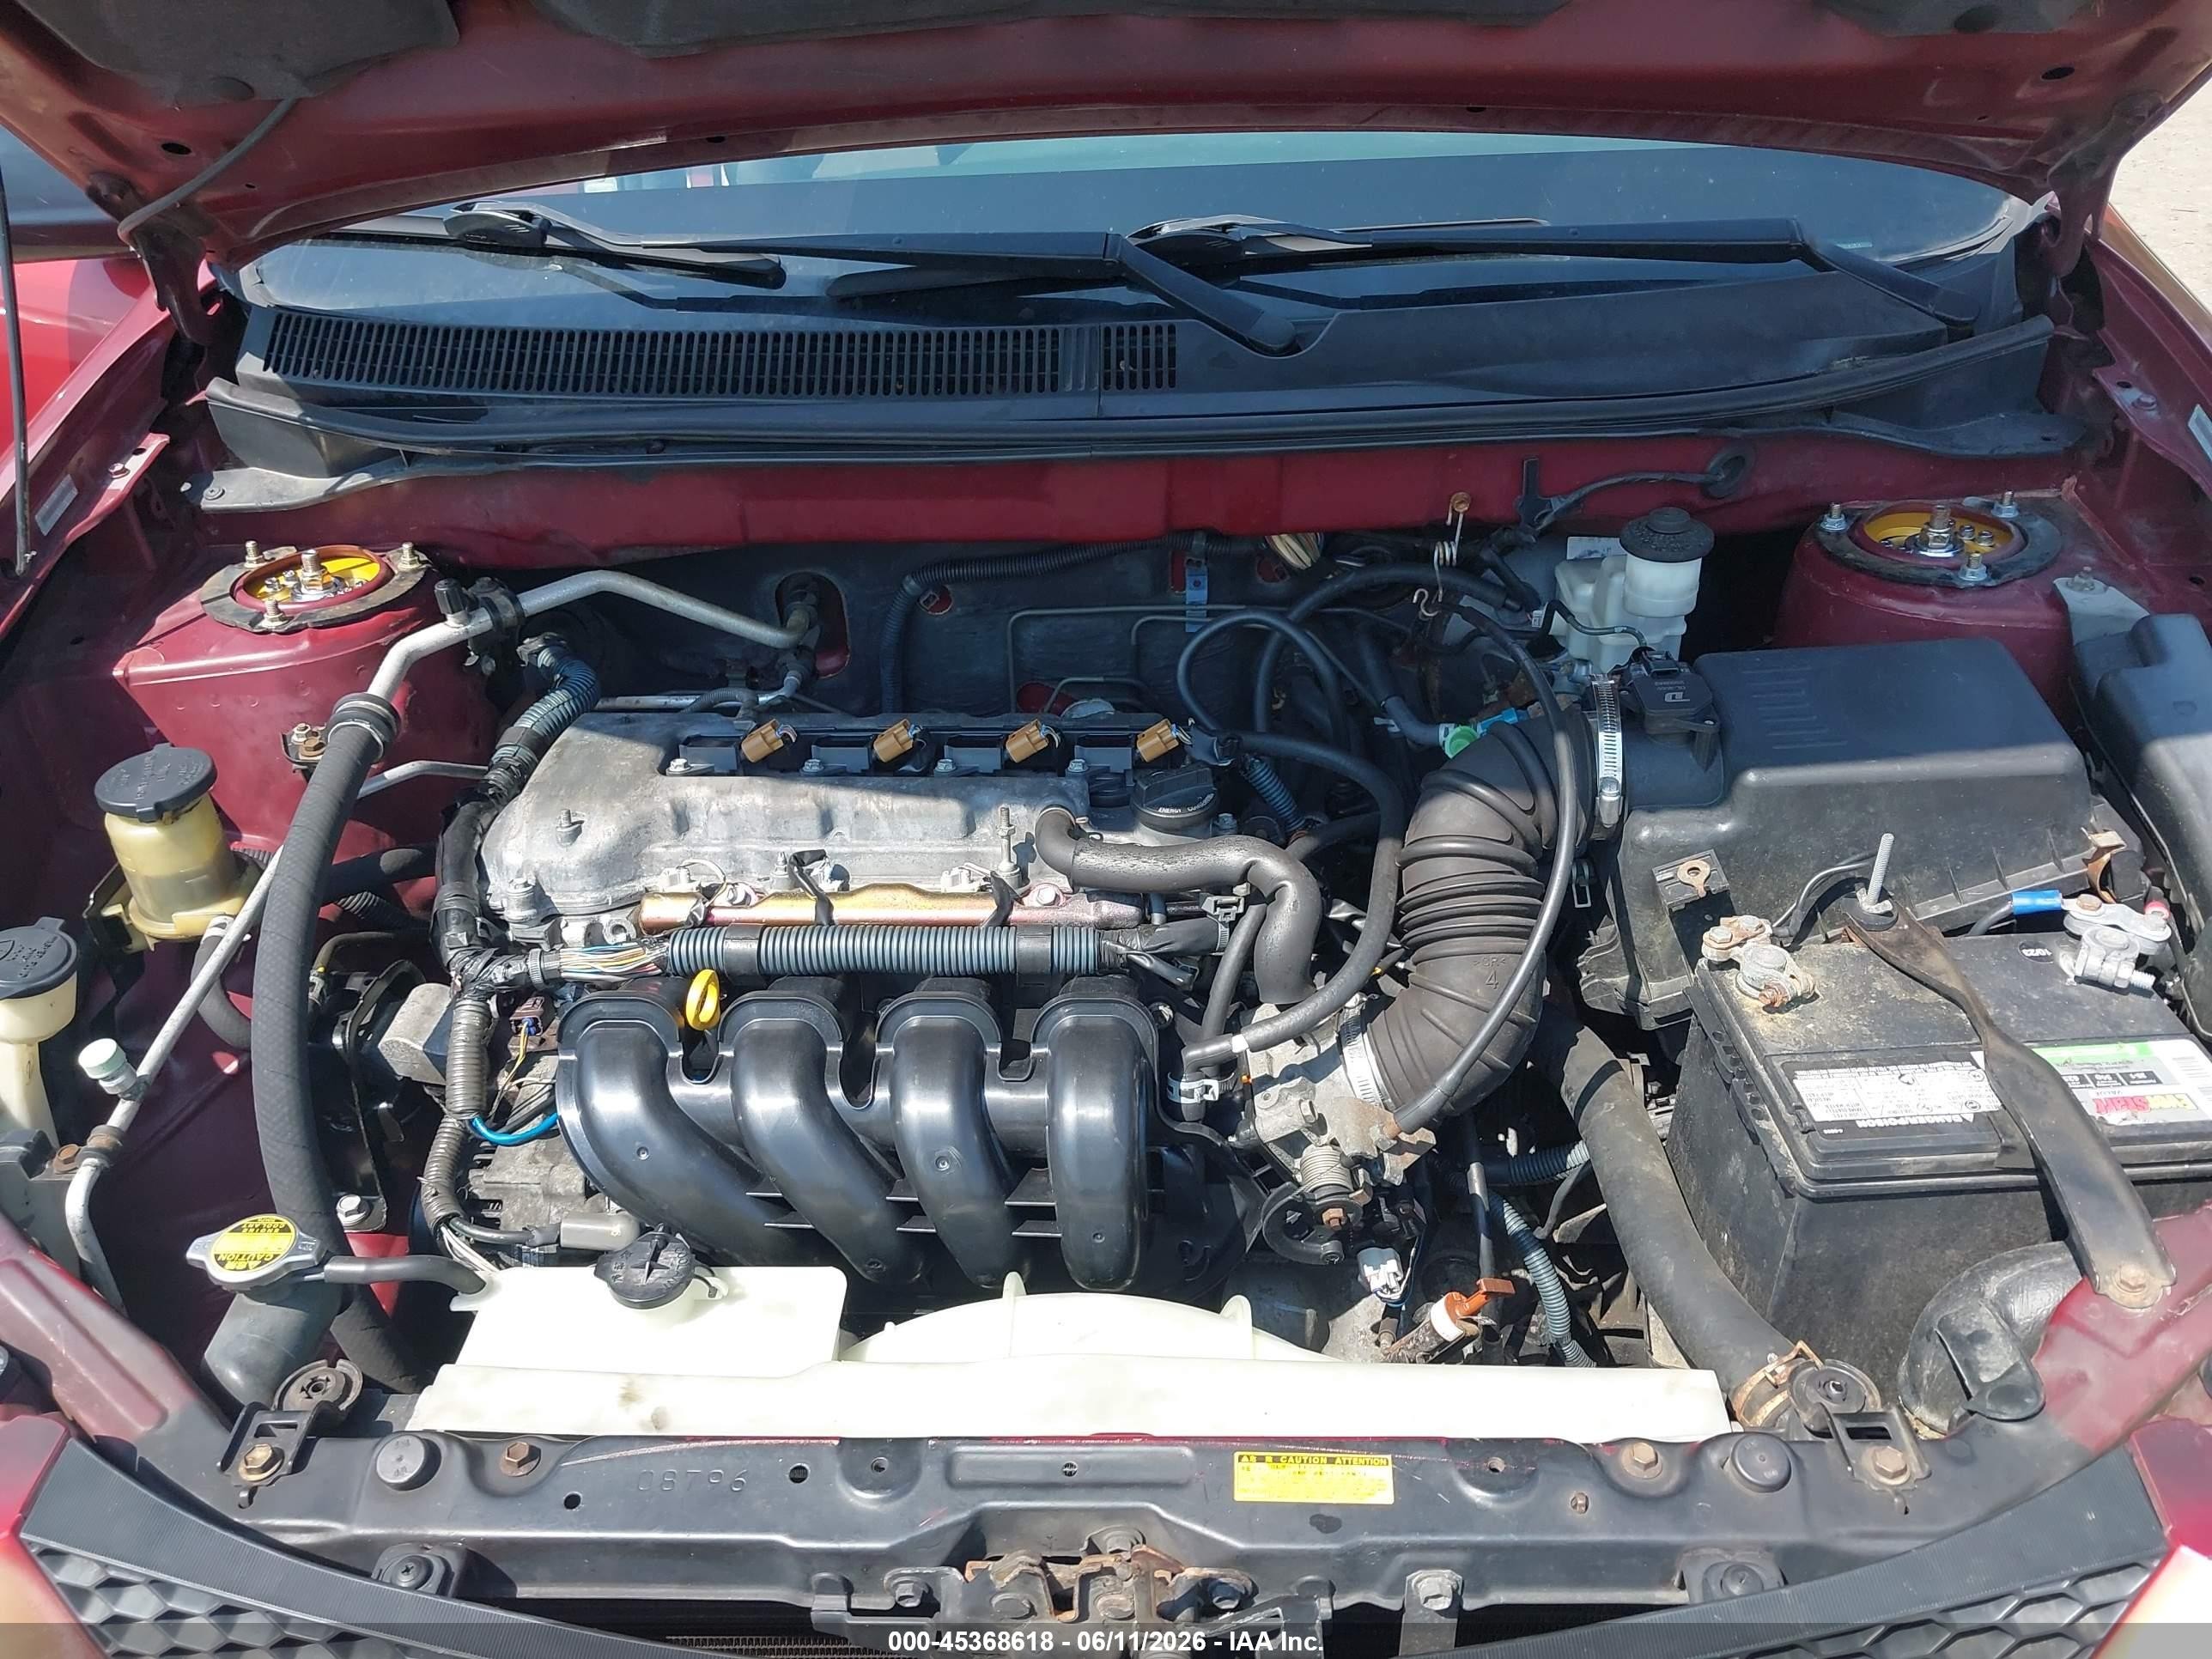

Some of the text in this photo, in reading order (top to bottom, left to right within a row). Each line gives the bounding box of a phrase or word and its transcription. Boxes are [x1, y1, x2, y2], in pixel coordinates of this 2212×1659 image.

[1485, 970, 1499, 989] 4
[217, 1253, 275, 1261] CAUTION
[1279, 1455, 1388, 1466] CAUTION ATTENTION
